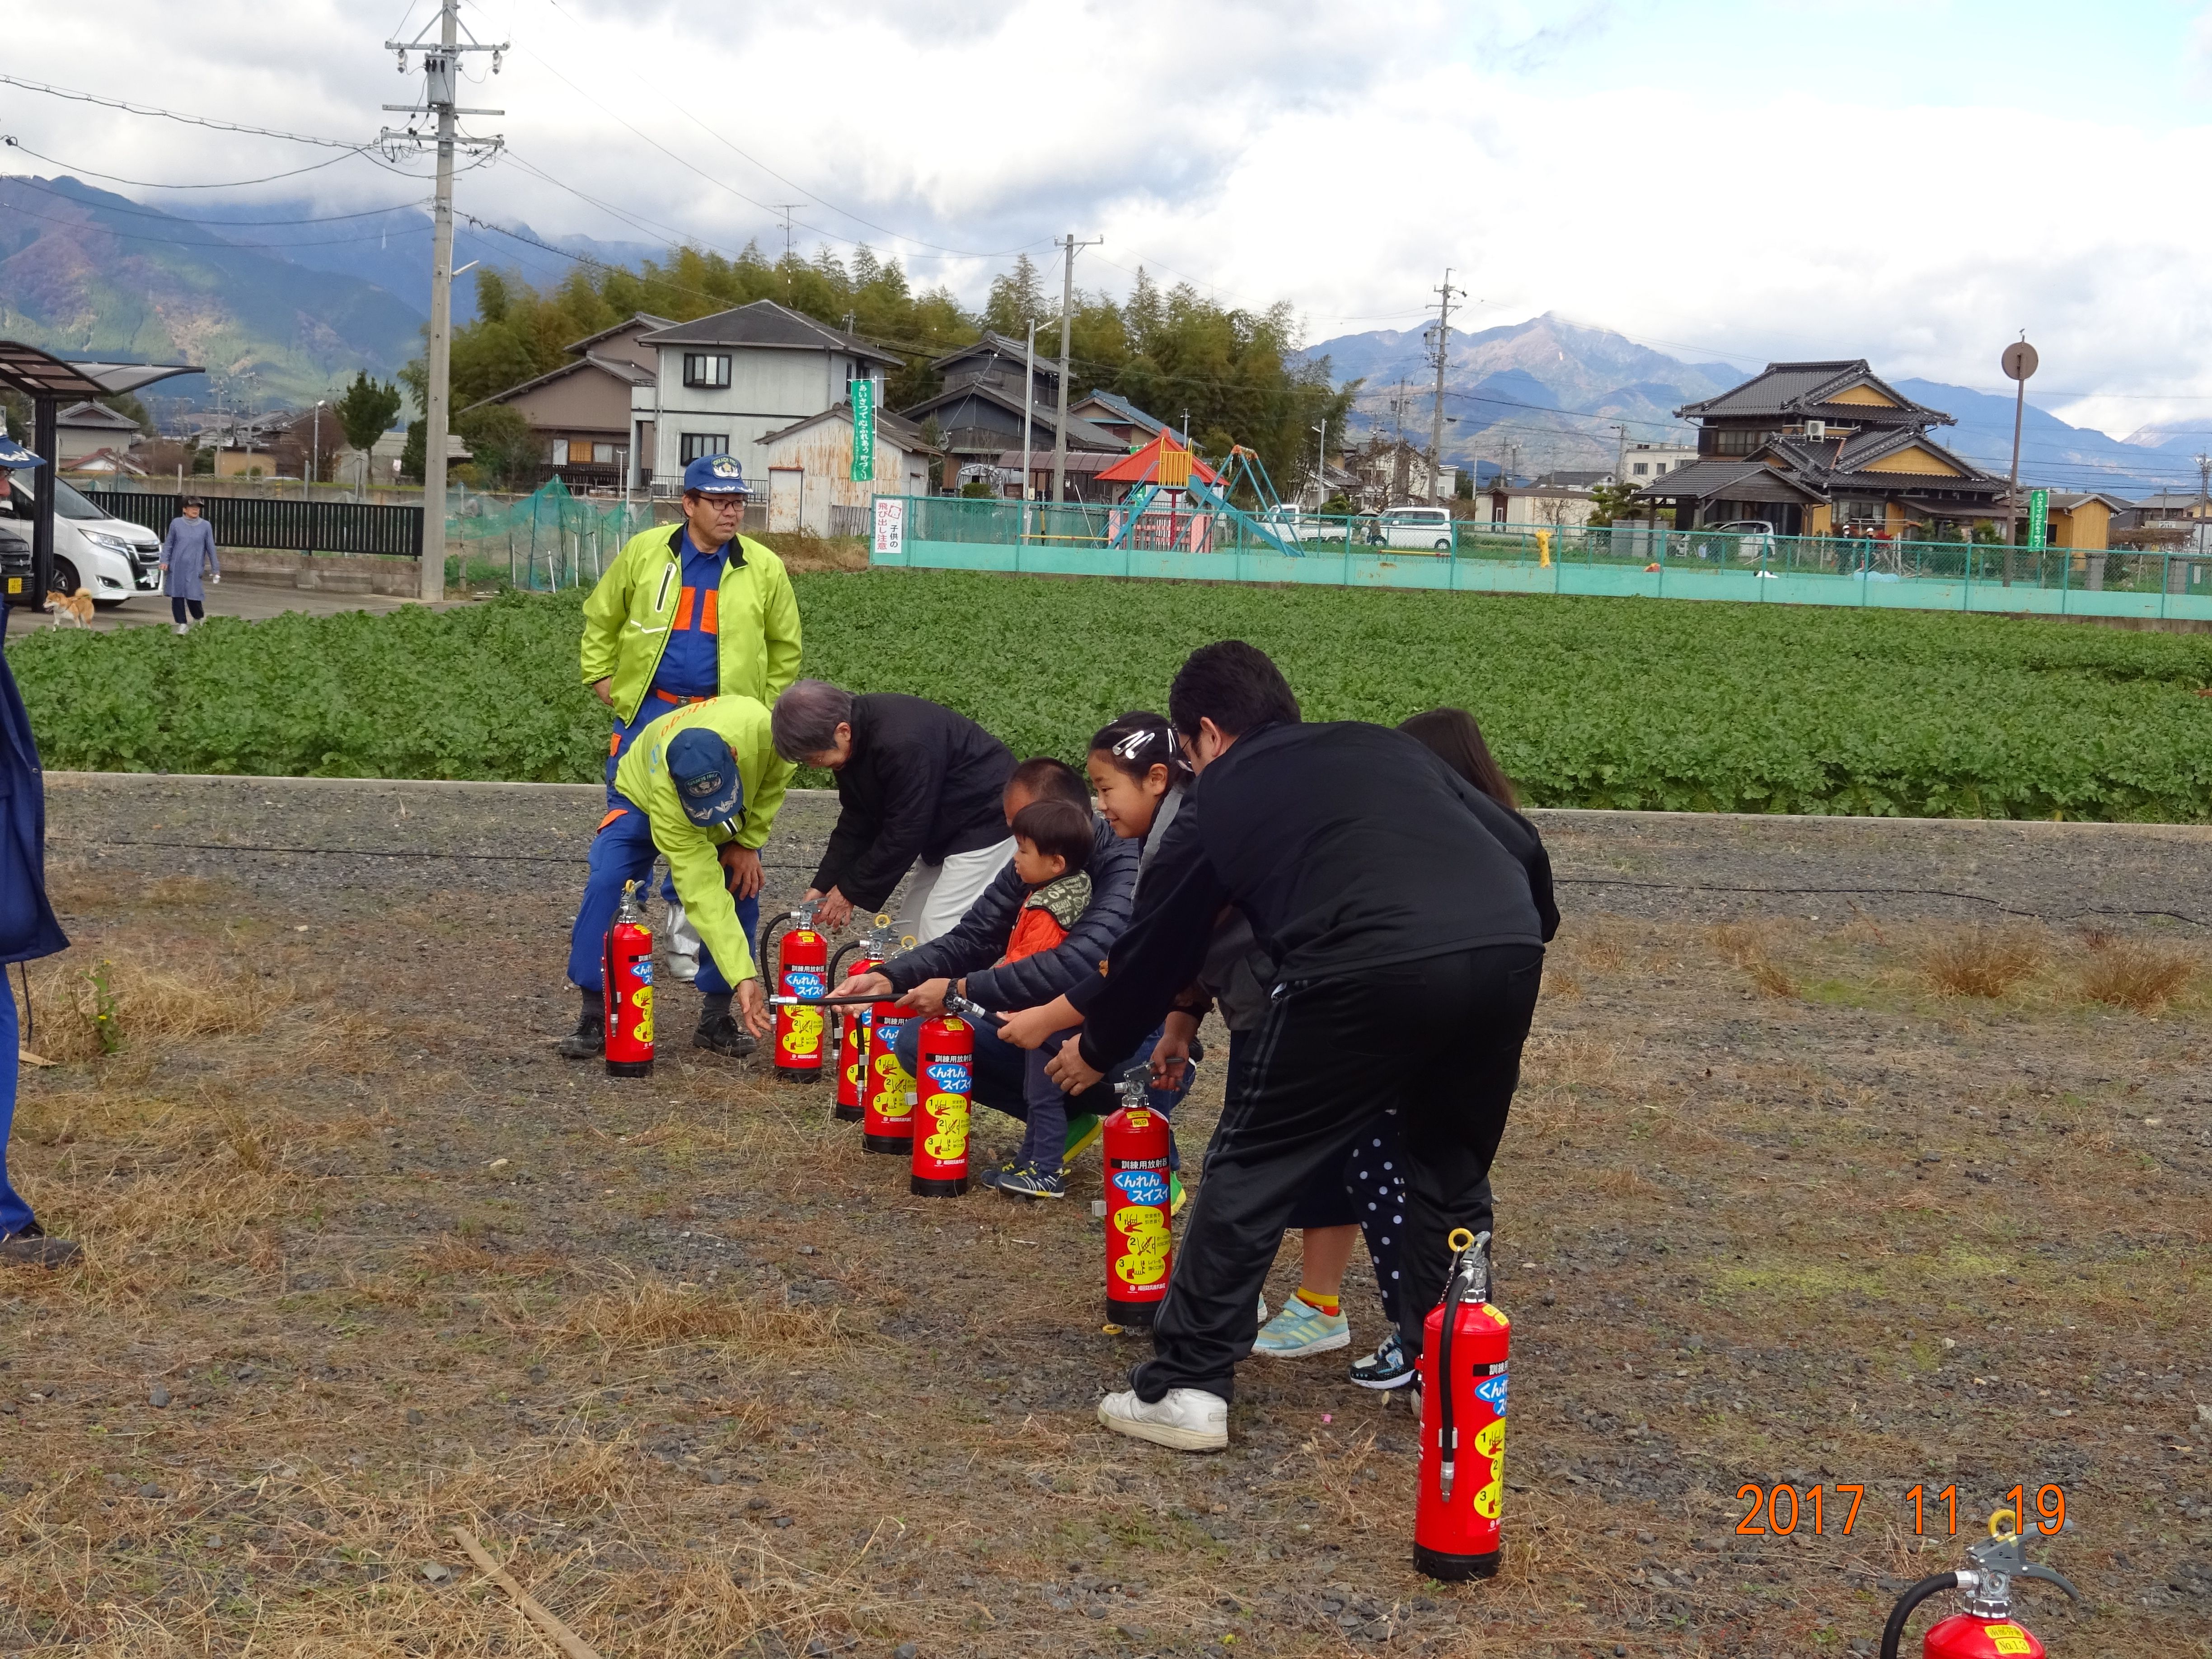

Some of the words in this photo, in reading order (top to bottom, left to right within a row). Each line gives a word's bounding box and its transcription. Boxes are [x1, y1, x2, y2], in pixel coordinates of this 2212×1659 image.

[877, 502, 888, 550] 飛び出し注意
[890, 525, 898, 548] 子供の
[786, 975, 818, 985] くんれん
[798, 986, 825, 995] スイスイ
[928, 1067, 965, 1078] くんれん
[942, 1078, 972, 1090] スイスイ
[1121, 1158, 1167, 1169] 訓練用放射器
[1115, 1175, 1159, 1188] くんれん
[1132, 1186, 1169, 1202] スイスイ
[1117, 1213, 1121, 1221] 1
[1119, 1259, 1125, 1267] 3
[1481, 1432, 1486, 1443] 1
[1493, 1460, 1498, 1470] 2
[1480, 1491, 1486, 1501] 3
